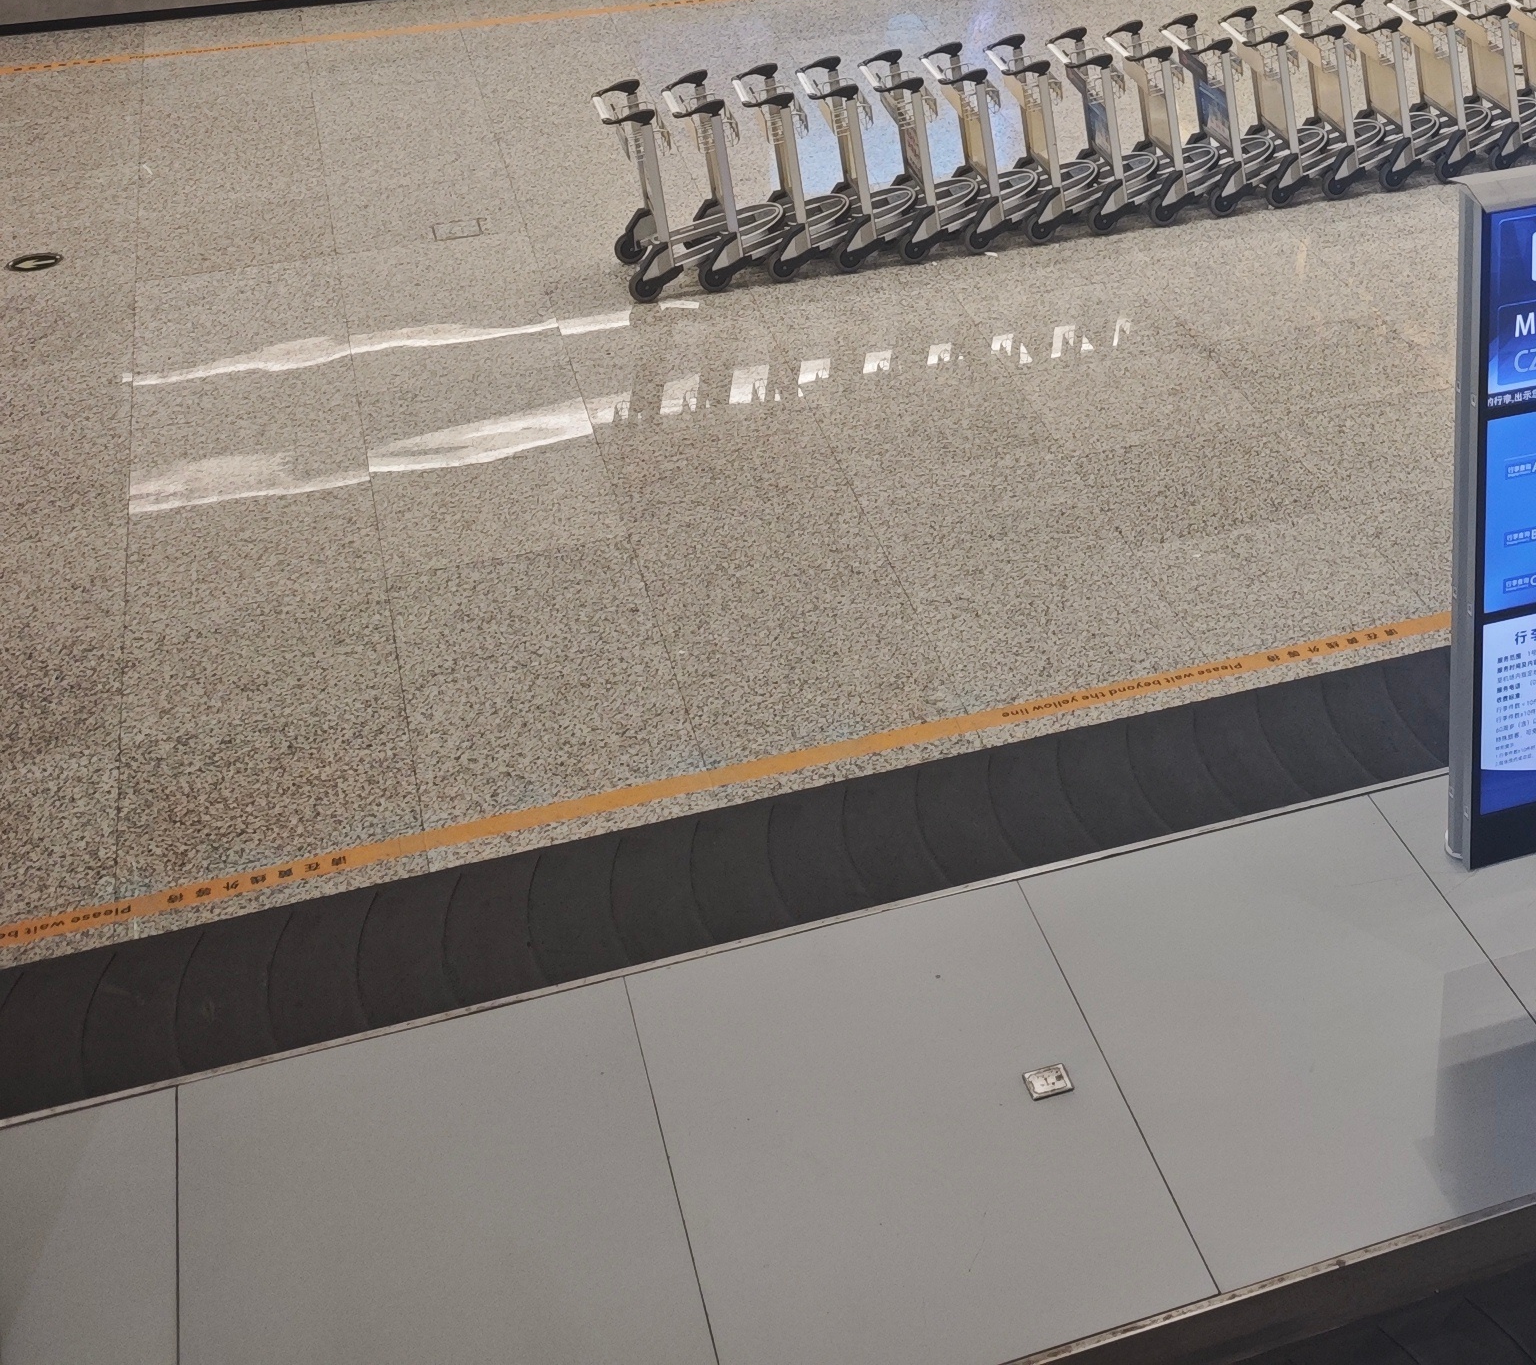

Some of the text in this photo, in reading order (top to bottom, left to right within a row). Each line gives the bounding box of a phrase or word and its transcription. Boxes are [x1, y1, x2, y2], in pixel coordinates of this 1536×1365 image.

[1165, 671, 1194, 684] wait
[1198, 662, 1243, 677] Please
[1081, 690, 1104, 701] the
[1108, 678, 1163, 697] beyond
[1032, 694, 1079, 712] yellow
[1001, 707, 1029, 718] line
[71, 905, 132, 925] Please
[24, 919, 65, 936] wait
